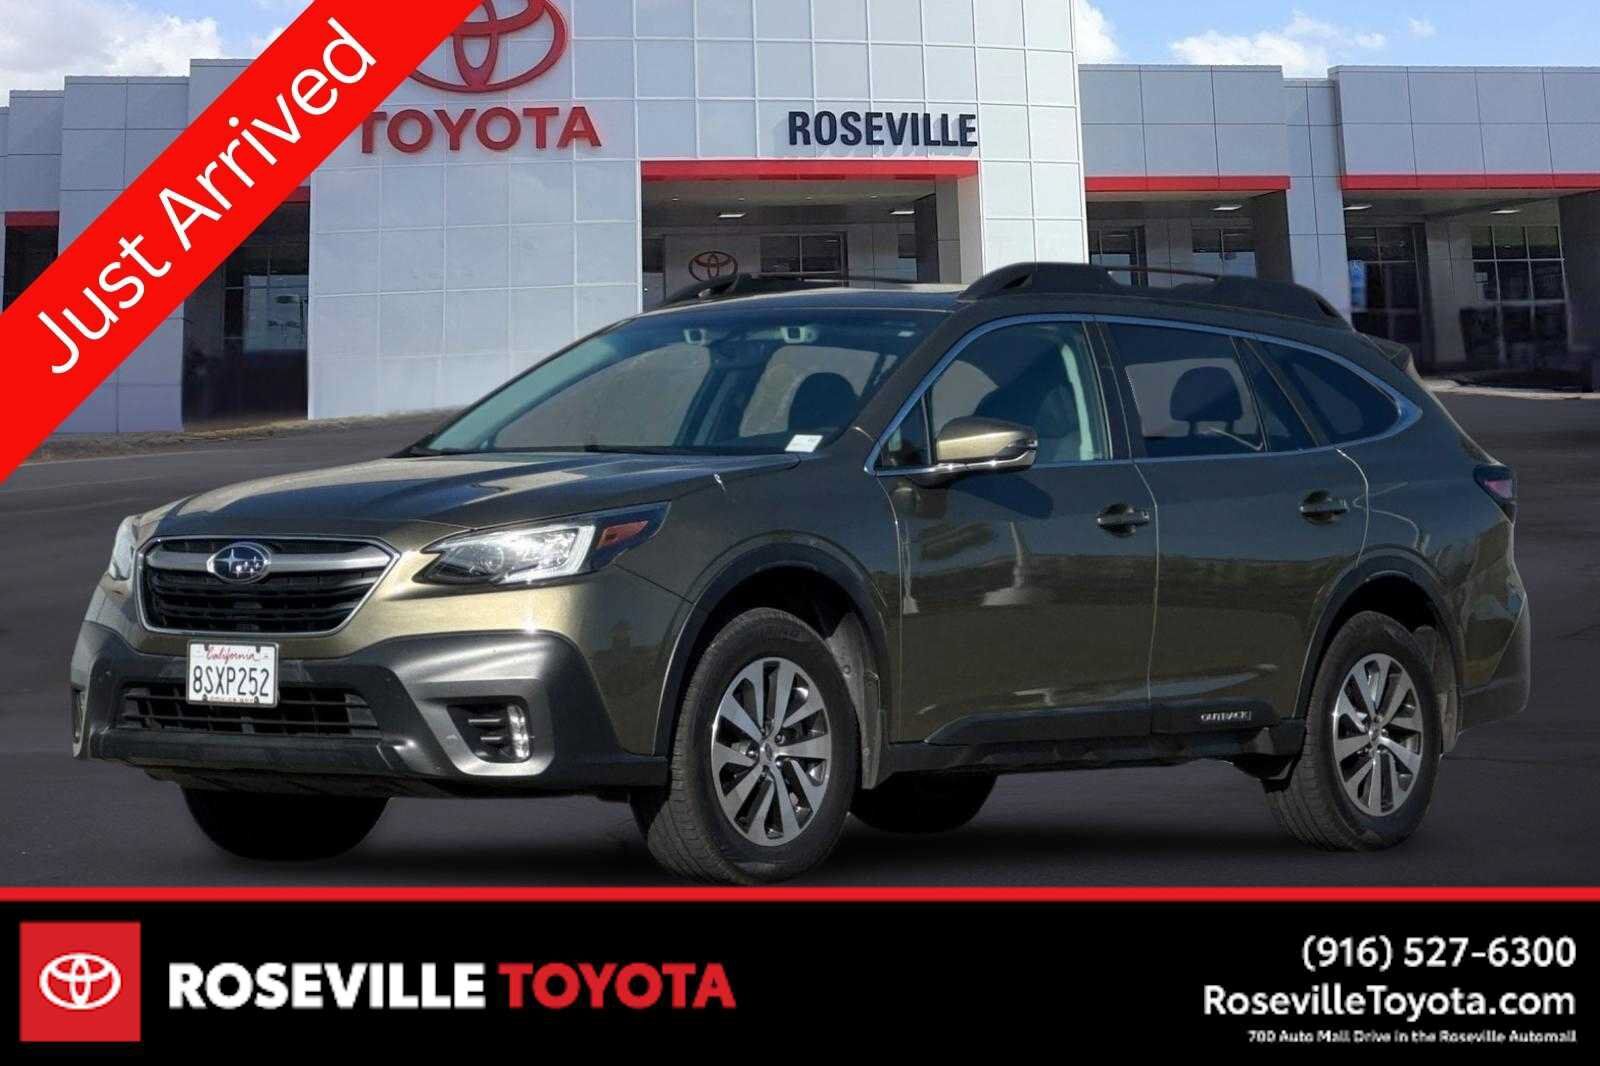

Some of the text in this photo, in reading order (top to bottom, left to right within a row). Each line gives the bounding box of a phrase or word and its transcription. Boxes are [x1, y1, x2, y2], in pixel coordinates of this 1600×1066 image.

[361, 107, 602, 154] TOYOTA
[788, 111, 978, 147] ROSEVILLE
[193, 665, 269, 696] 8SXP252
